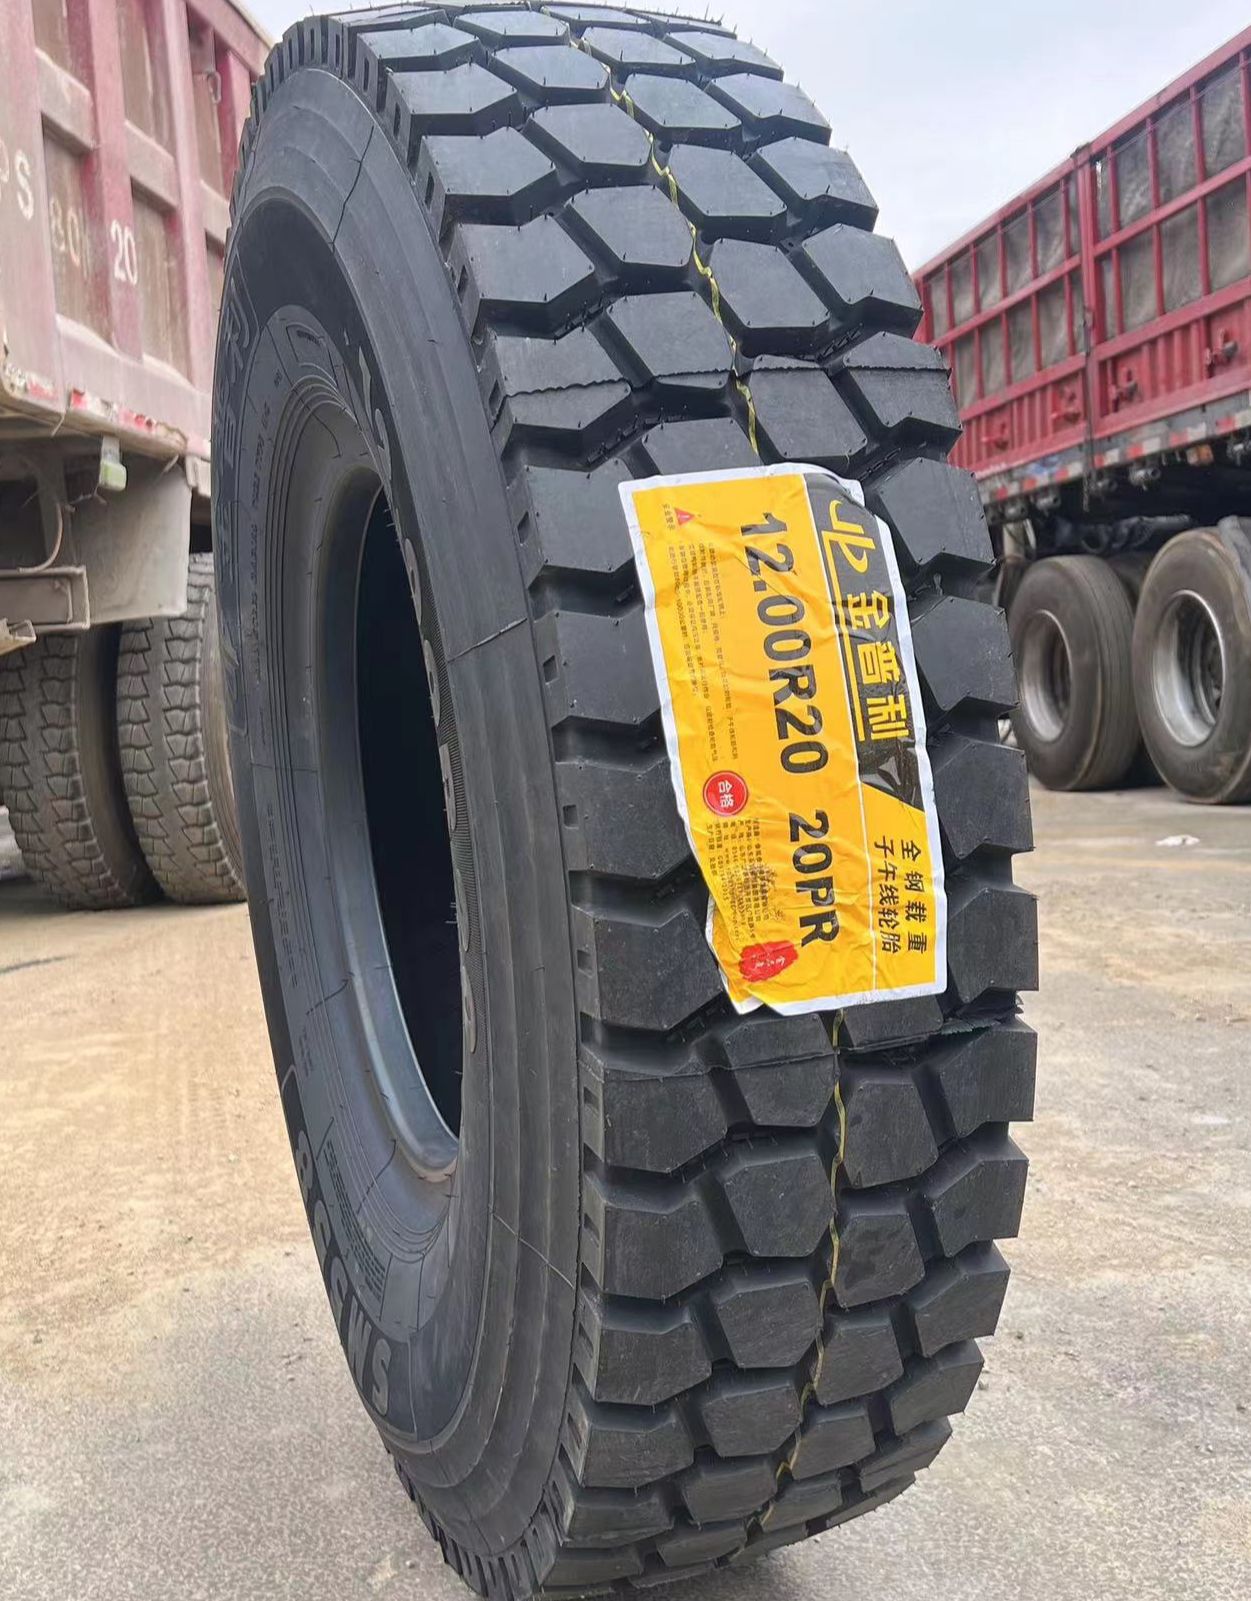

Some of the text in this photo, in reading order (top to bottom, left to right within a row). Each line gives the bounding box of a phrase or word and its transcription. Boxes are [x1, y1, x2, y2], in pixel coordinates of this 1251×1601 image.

[110, 218, 138, 286] 20
[847, 590, 910, 741] 金普利
[741, 512, 829, 774] 12.00R20
[788, 809, 840, 948] 20PR
[718, 780, 734, 808] 合格
[874, 835, 902, 954] 子午线轮胎
